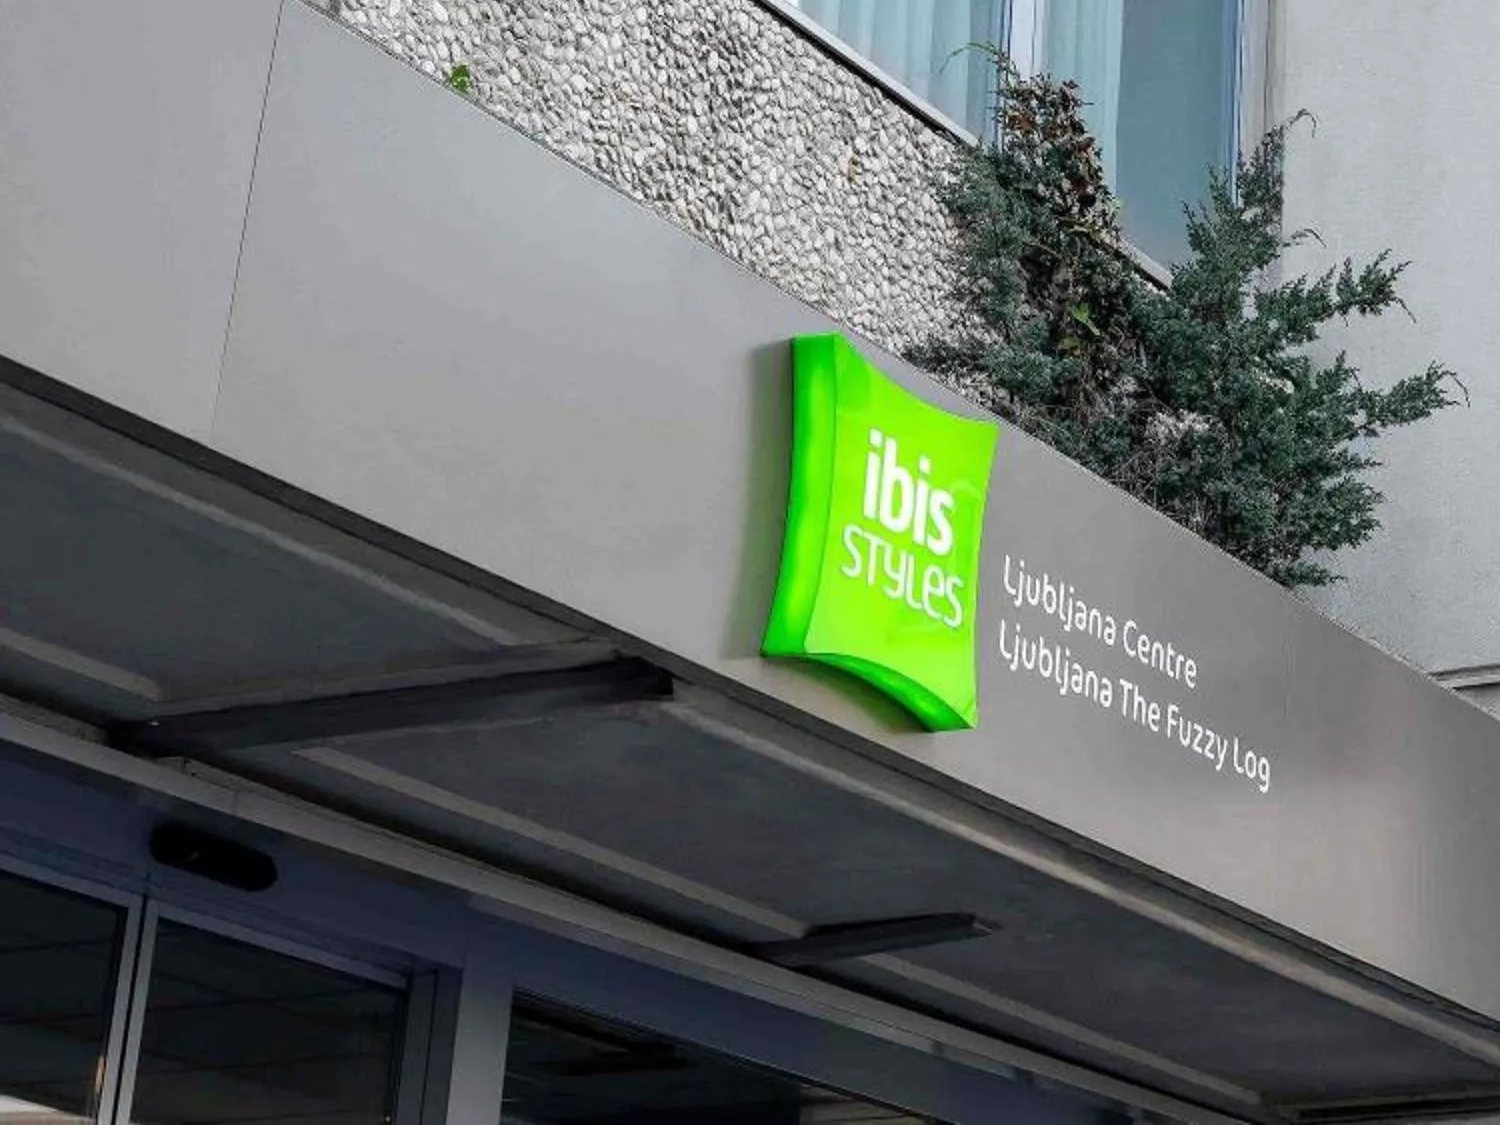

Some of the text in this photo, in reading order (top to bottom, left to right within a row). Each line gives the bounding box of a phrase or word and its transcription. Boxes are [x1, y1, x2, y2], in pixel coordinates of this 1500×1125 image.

[863, 428, 954, 556] ibis
[1002, 554, 1198, 689] Ljubljana Centre
[999, 619, 1271, 793] Ljubljana The Fuzzy Log
